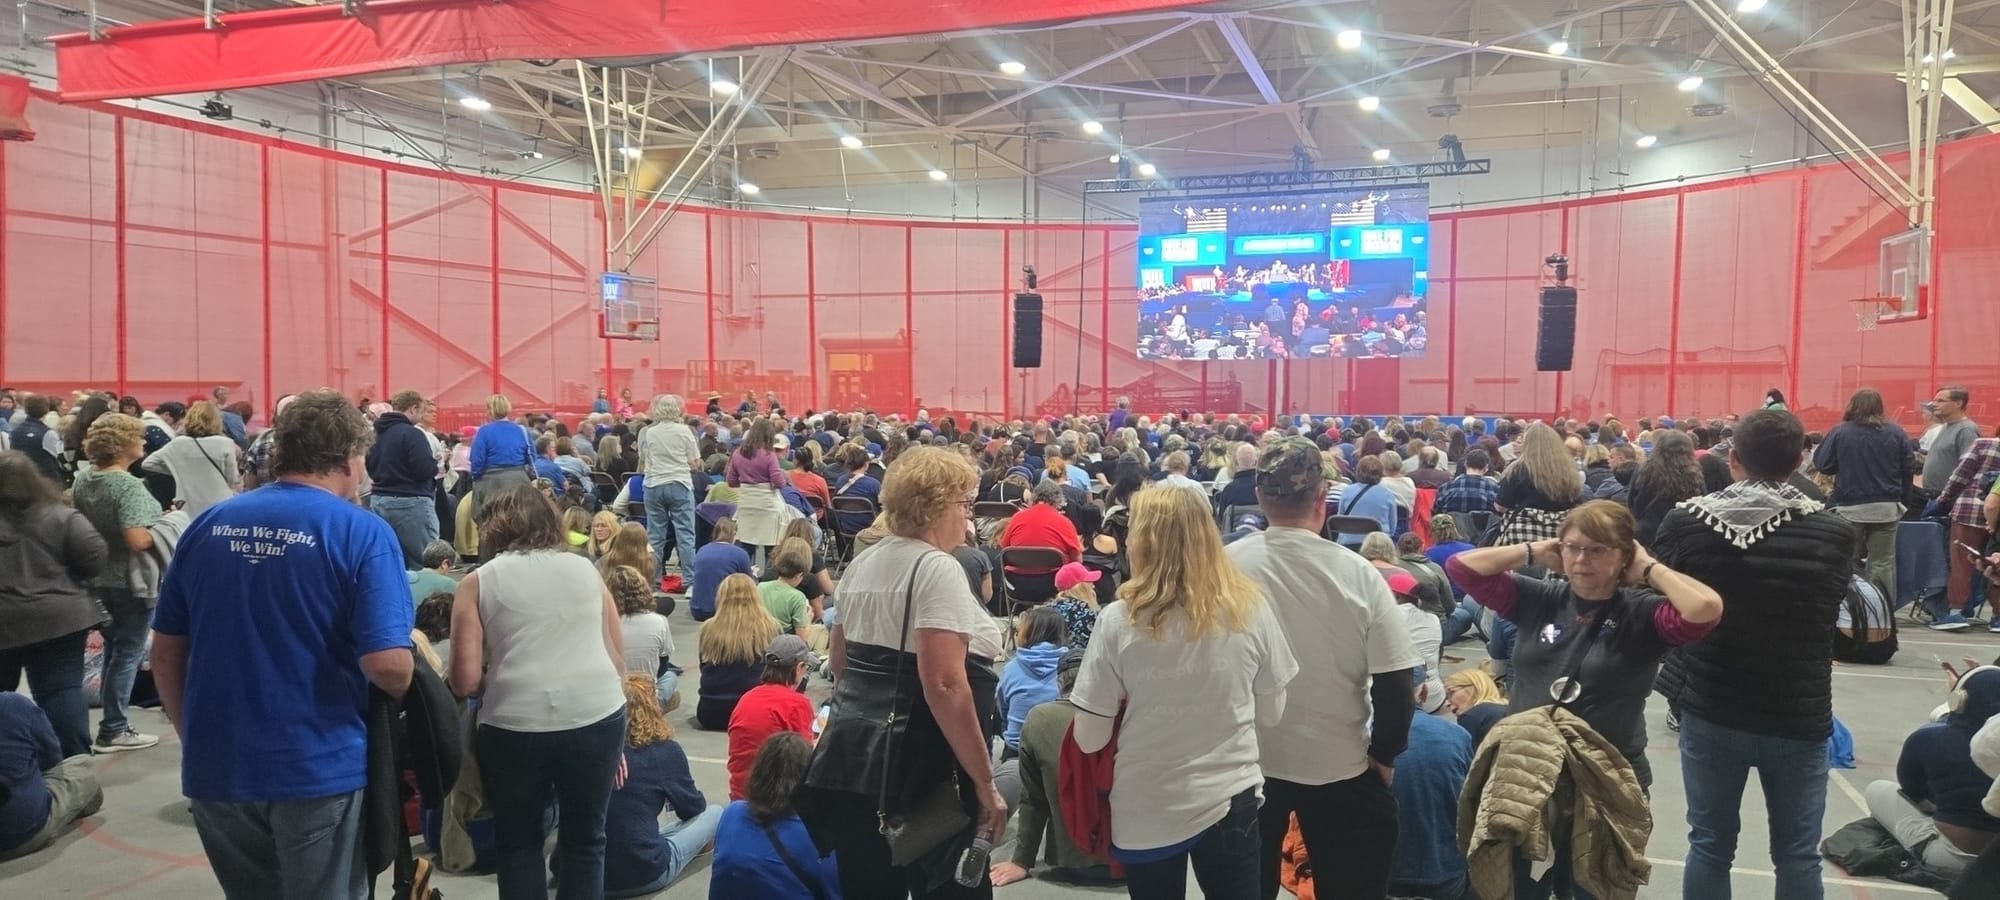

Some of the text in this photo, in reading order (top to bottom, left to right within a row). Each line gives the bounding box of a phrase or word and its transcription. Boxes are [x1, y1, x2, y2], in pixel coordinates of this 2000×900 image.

[212, 526, 316, 547] When We Fight,
[230, 541, 286, 555] We Win!
